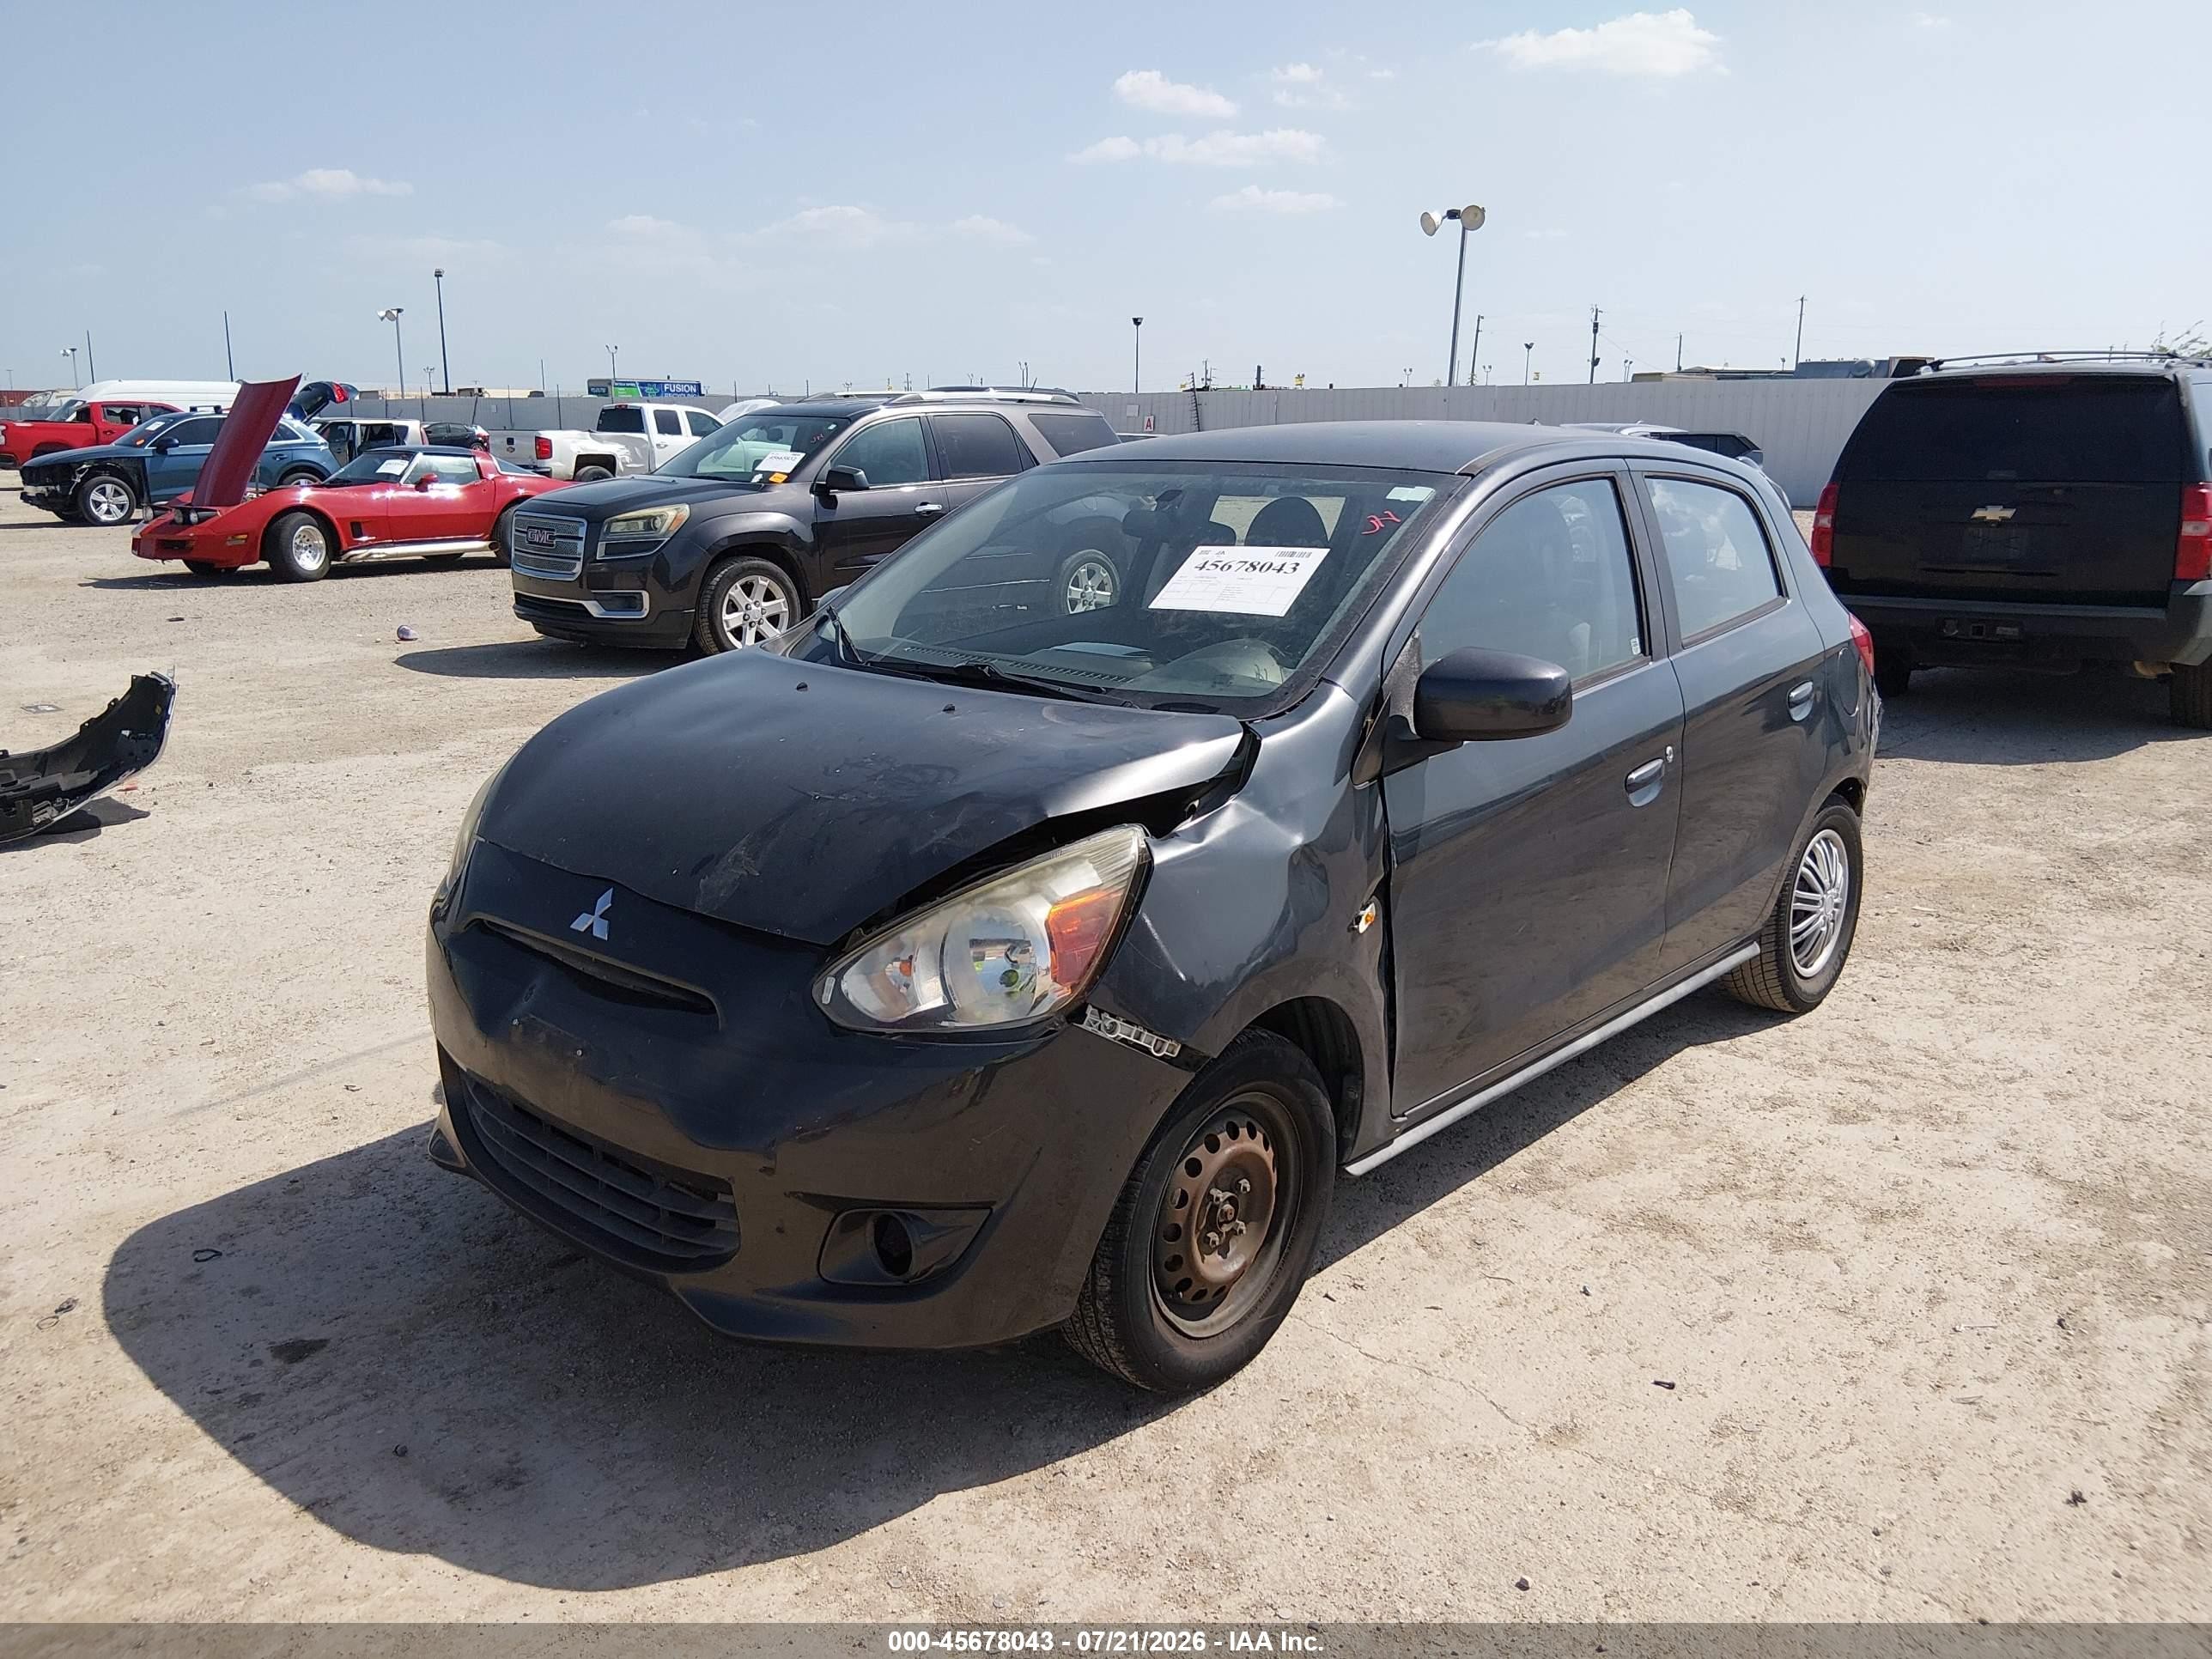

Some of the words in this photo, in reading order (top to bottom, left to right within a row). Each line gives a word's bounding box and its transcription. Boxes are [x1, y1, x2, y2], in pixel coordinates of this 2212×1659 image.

[664, 383, 696, 392] FUSION
[1146, 417, 1152, 430] A
[528, 528, 556, 544] GMC
[1194, 559, 1301, 574] 45678043
